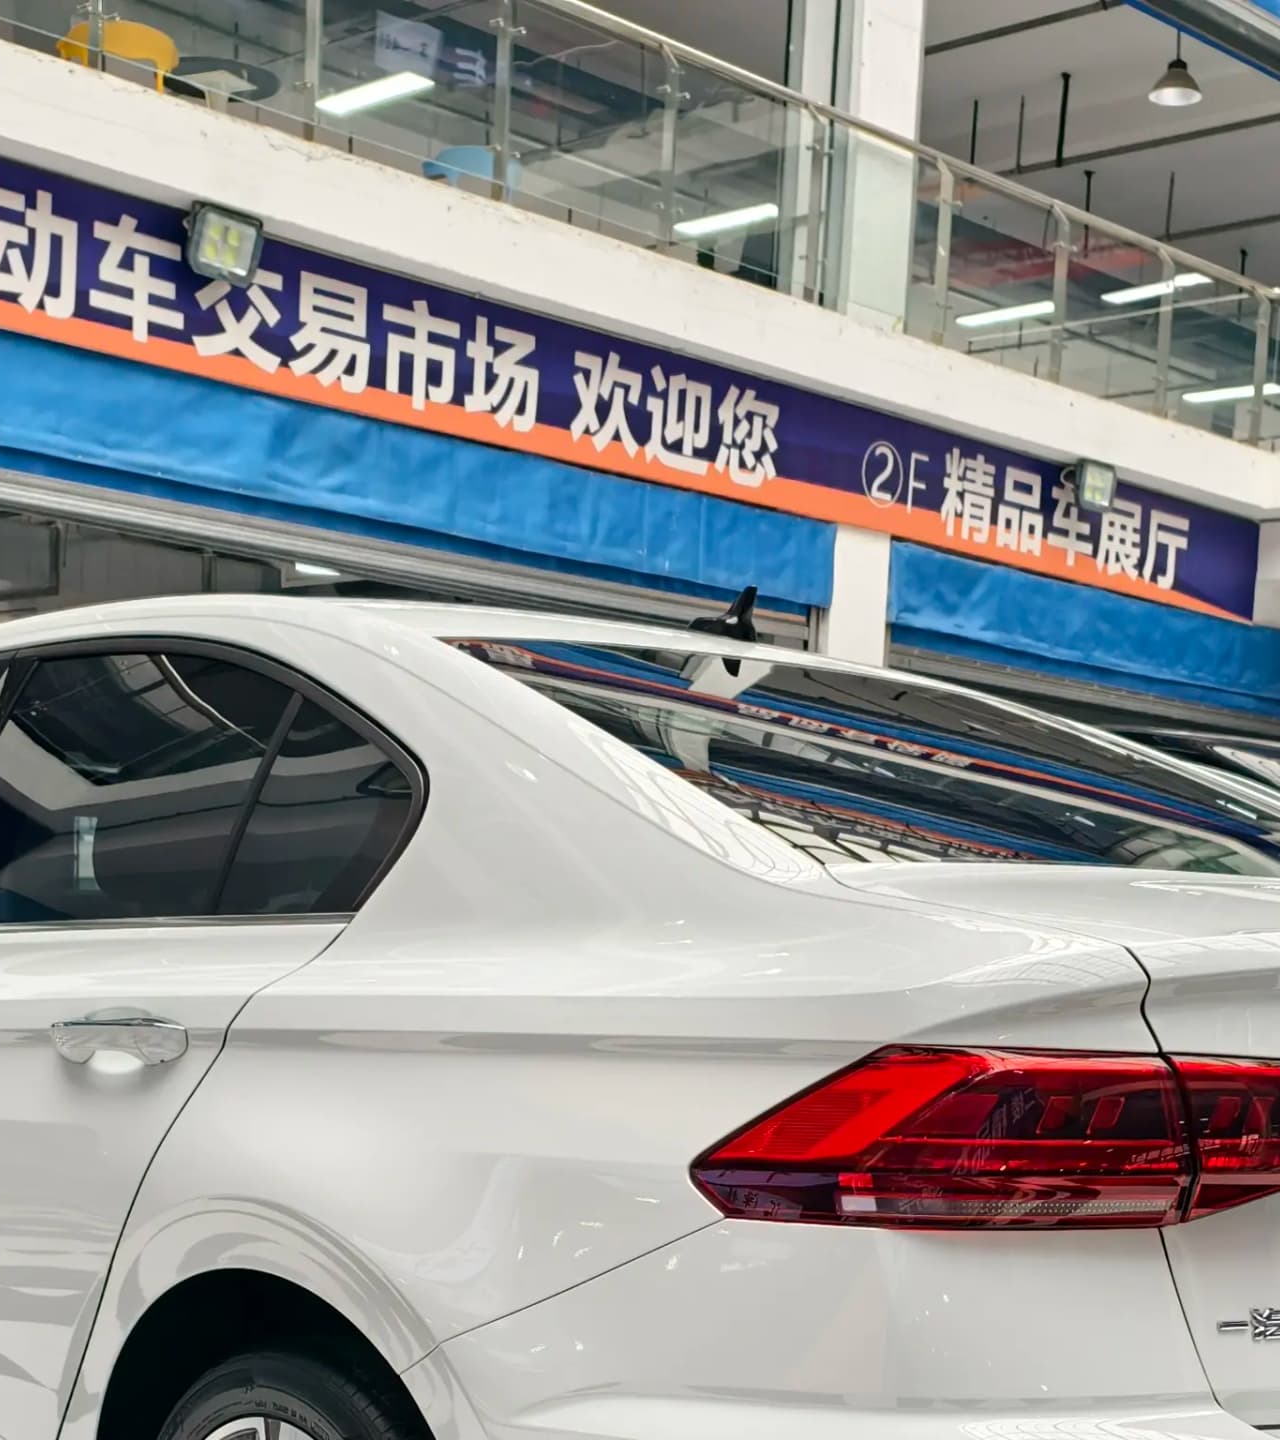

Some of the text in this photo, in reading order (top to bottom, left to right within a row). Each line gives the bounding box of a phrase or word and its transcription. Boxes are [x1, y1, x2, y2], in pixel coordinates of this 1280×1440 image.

[570, 349, 781, 490] 欢迎您
[940, 446, 1190, 590] 精品车展厅
